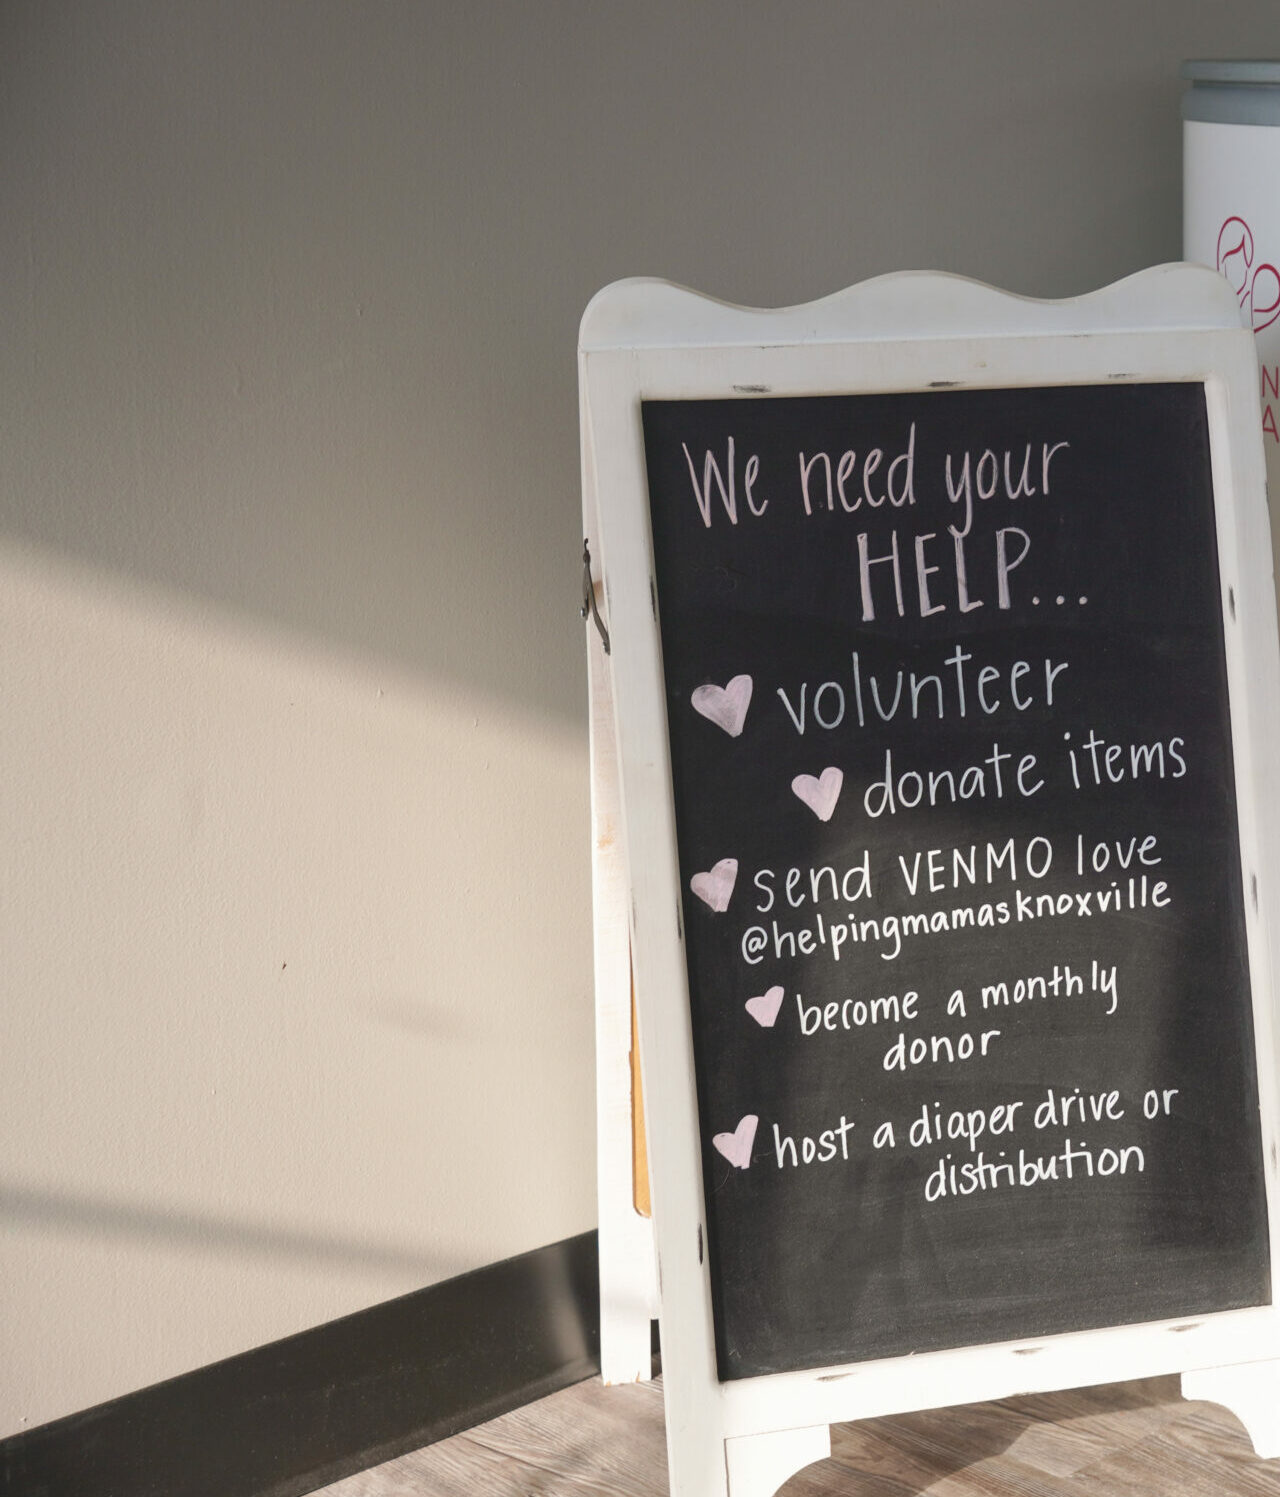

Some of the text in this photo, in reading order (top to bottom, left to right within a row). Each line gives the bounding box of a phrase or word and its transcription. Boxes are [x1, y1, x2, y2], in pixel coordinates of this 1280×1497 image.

[682, 422, 1070, 537] We need your
[856, 526, 1089, 622] HELP...
[777, 645, 1070, 735] volunteer
[863, 730, 1187, 818] donate items
[753, 834, 1162, 912] send VENMO love
[741, 876, 1171, 964] @helpingmamasknoxville
[796, 961, 1118, 1035] become a monthly
[883, 1029, 1001, 1071] donor
[773, 1088, 1179, 1169] host a diaper drive or
[924, 1140, 1145, 1201] distribution
